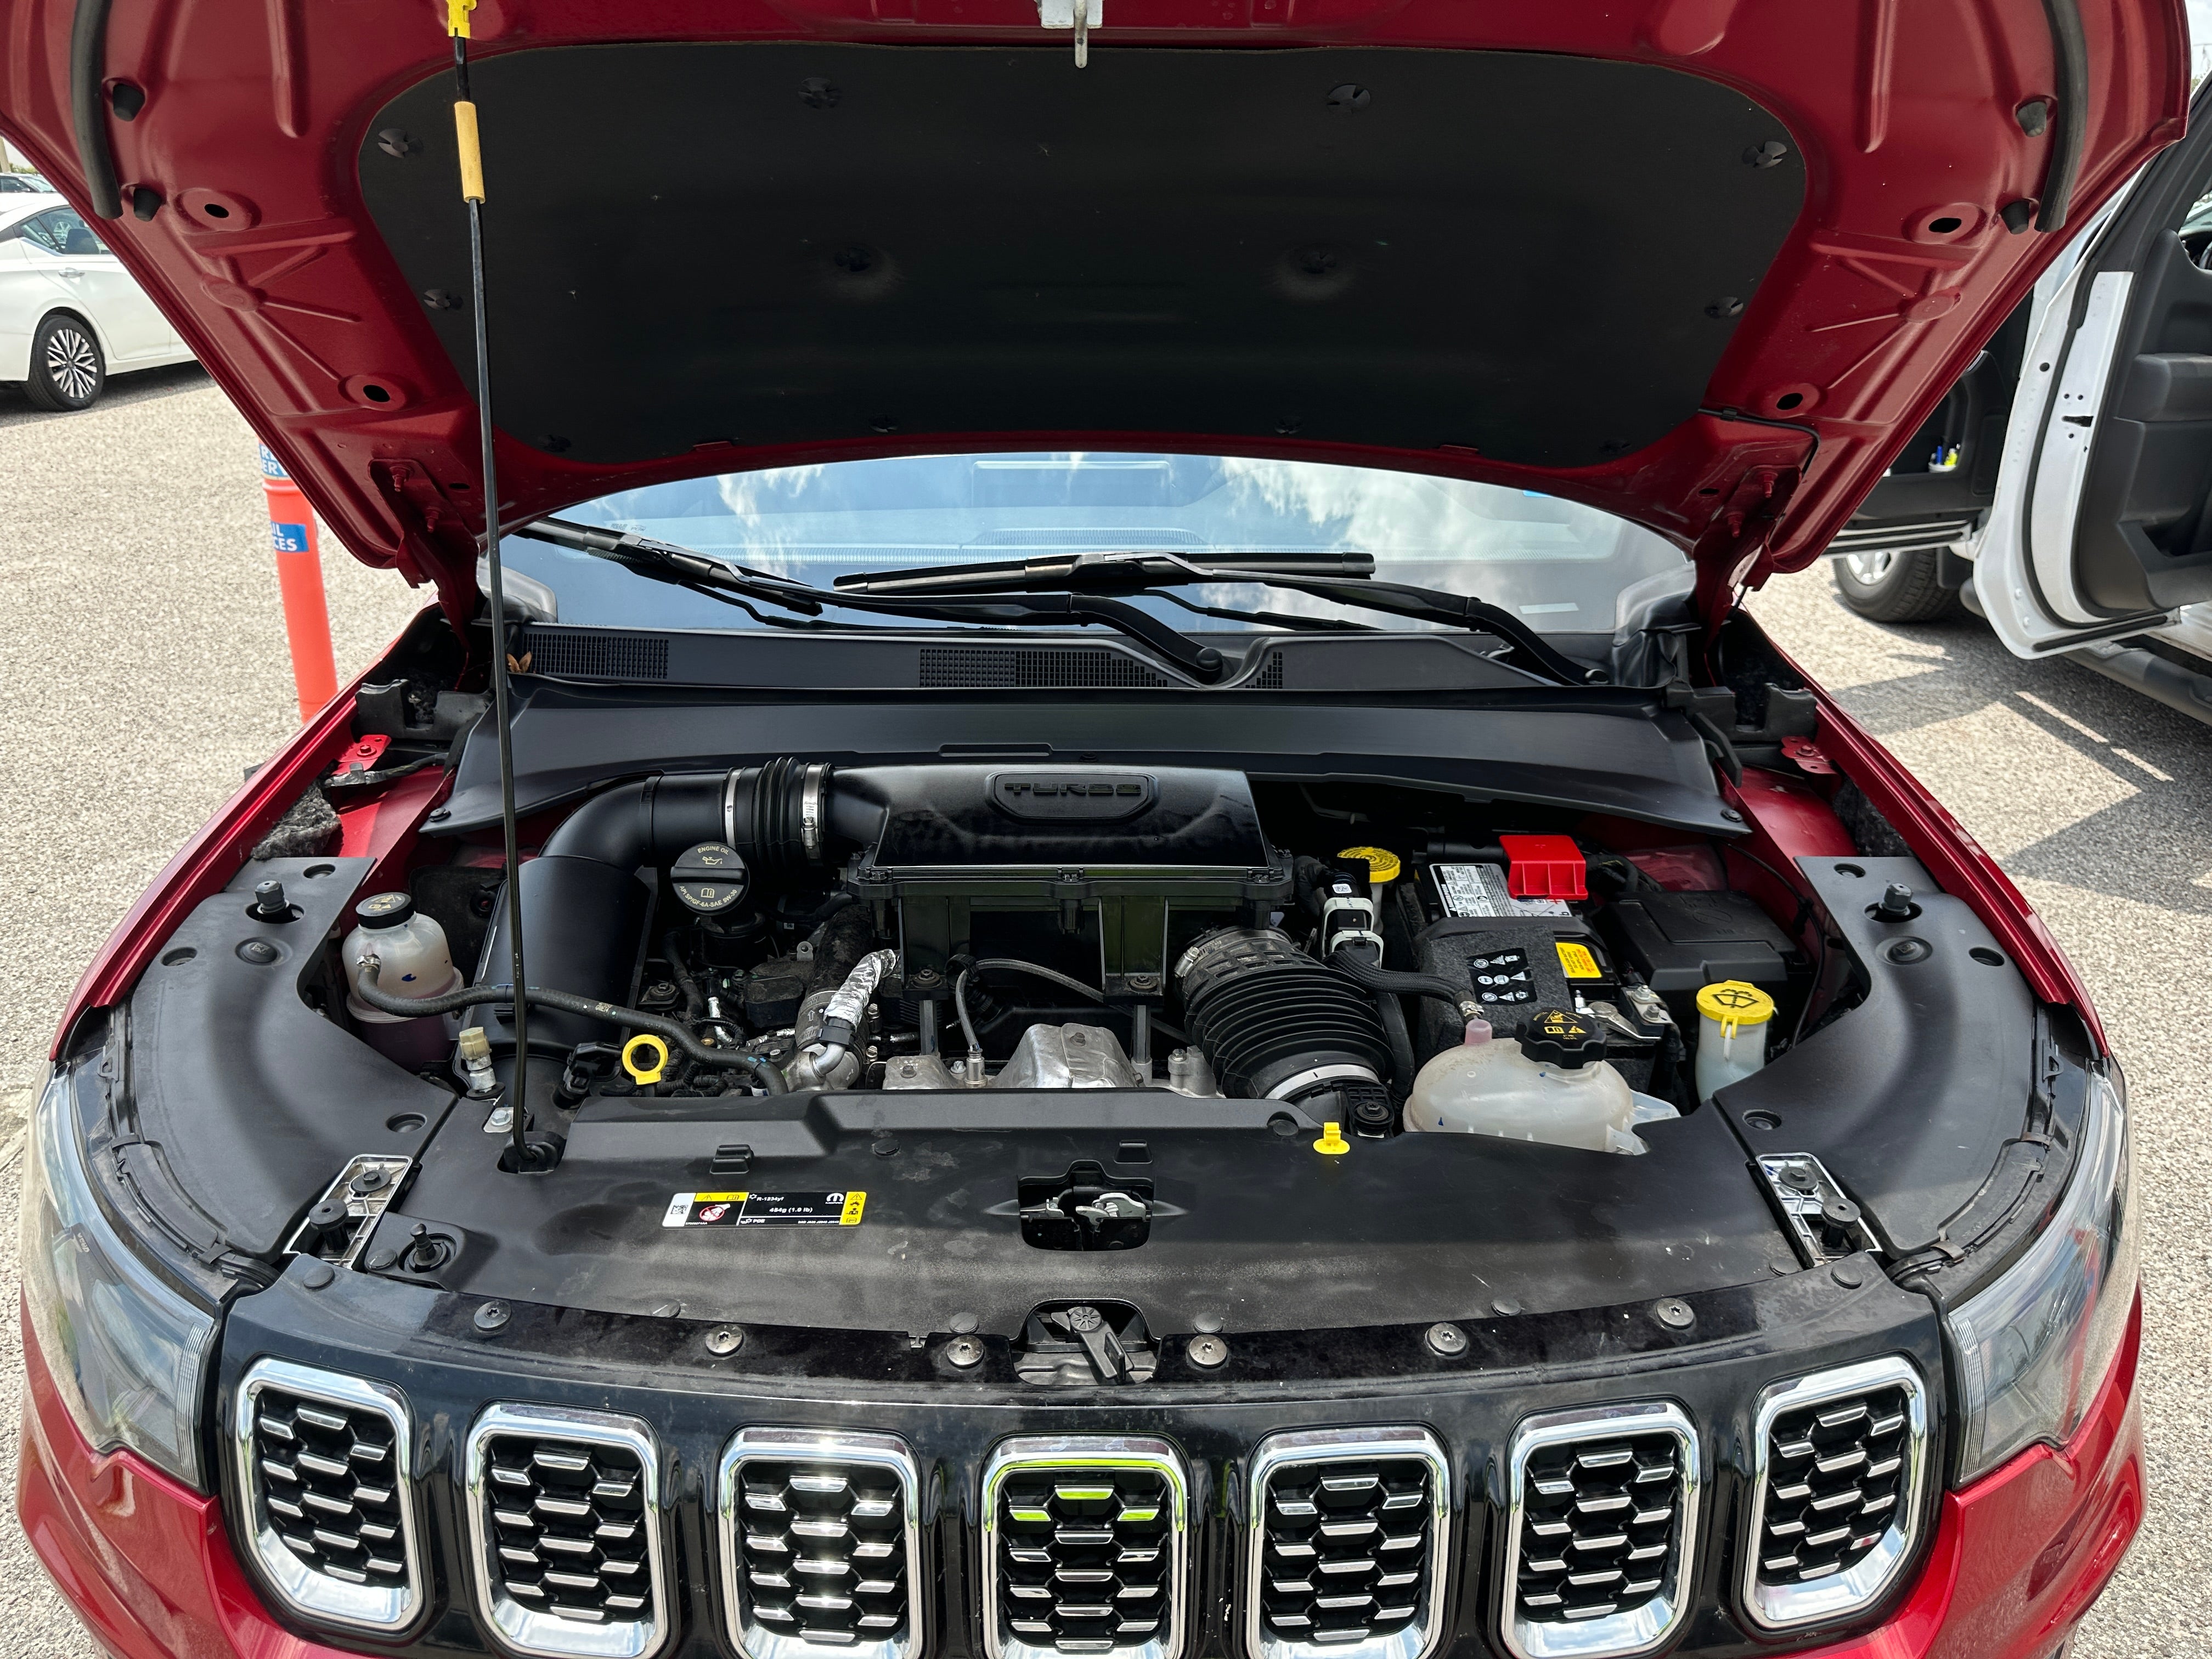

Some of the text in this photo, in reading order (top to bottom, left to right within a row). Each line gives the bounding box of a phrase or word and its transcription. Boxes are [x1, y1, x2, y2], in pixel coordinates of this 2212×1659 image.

[1004, 782, 1142, 795] TURBO
[697, 845, 720, 854] ENGINE
[679, 885, 687, 895] API
[723, 889, 737, 903] 5W-30
